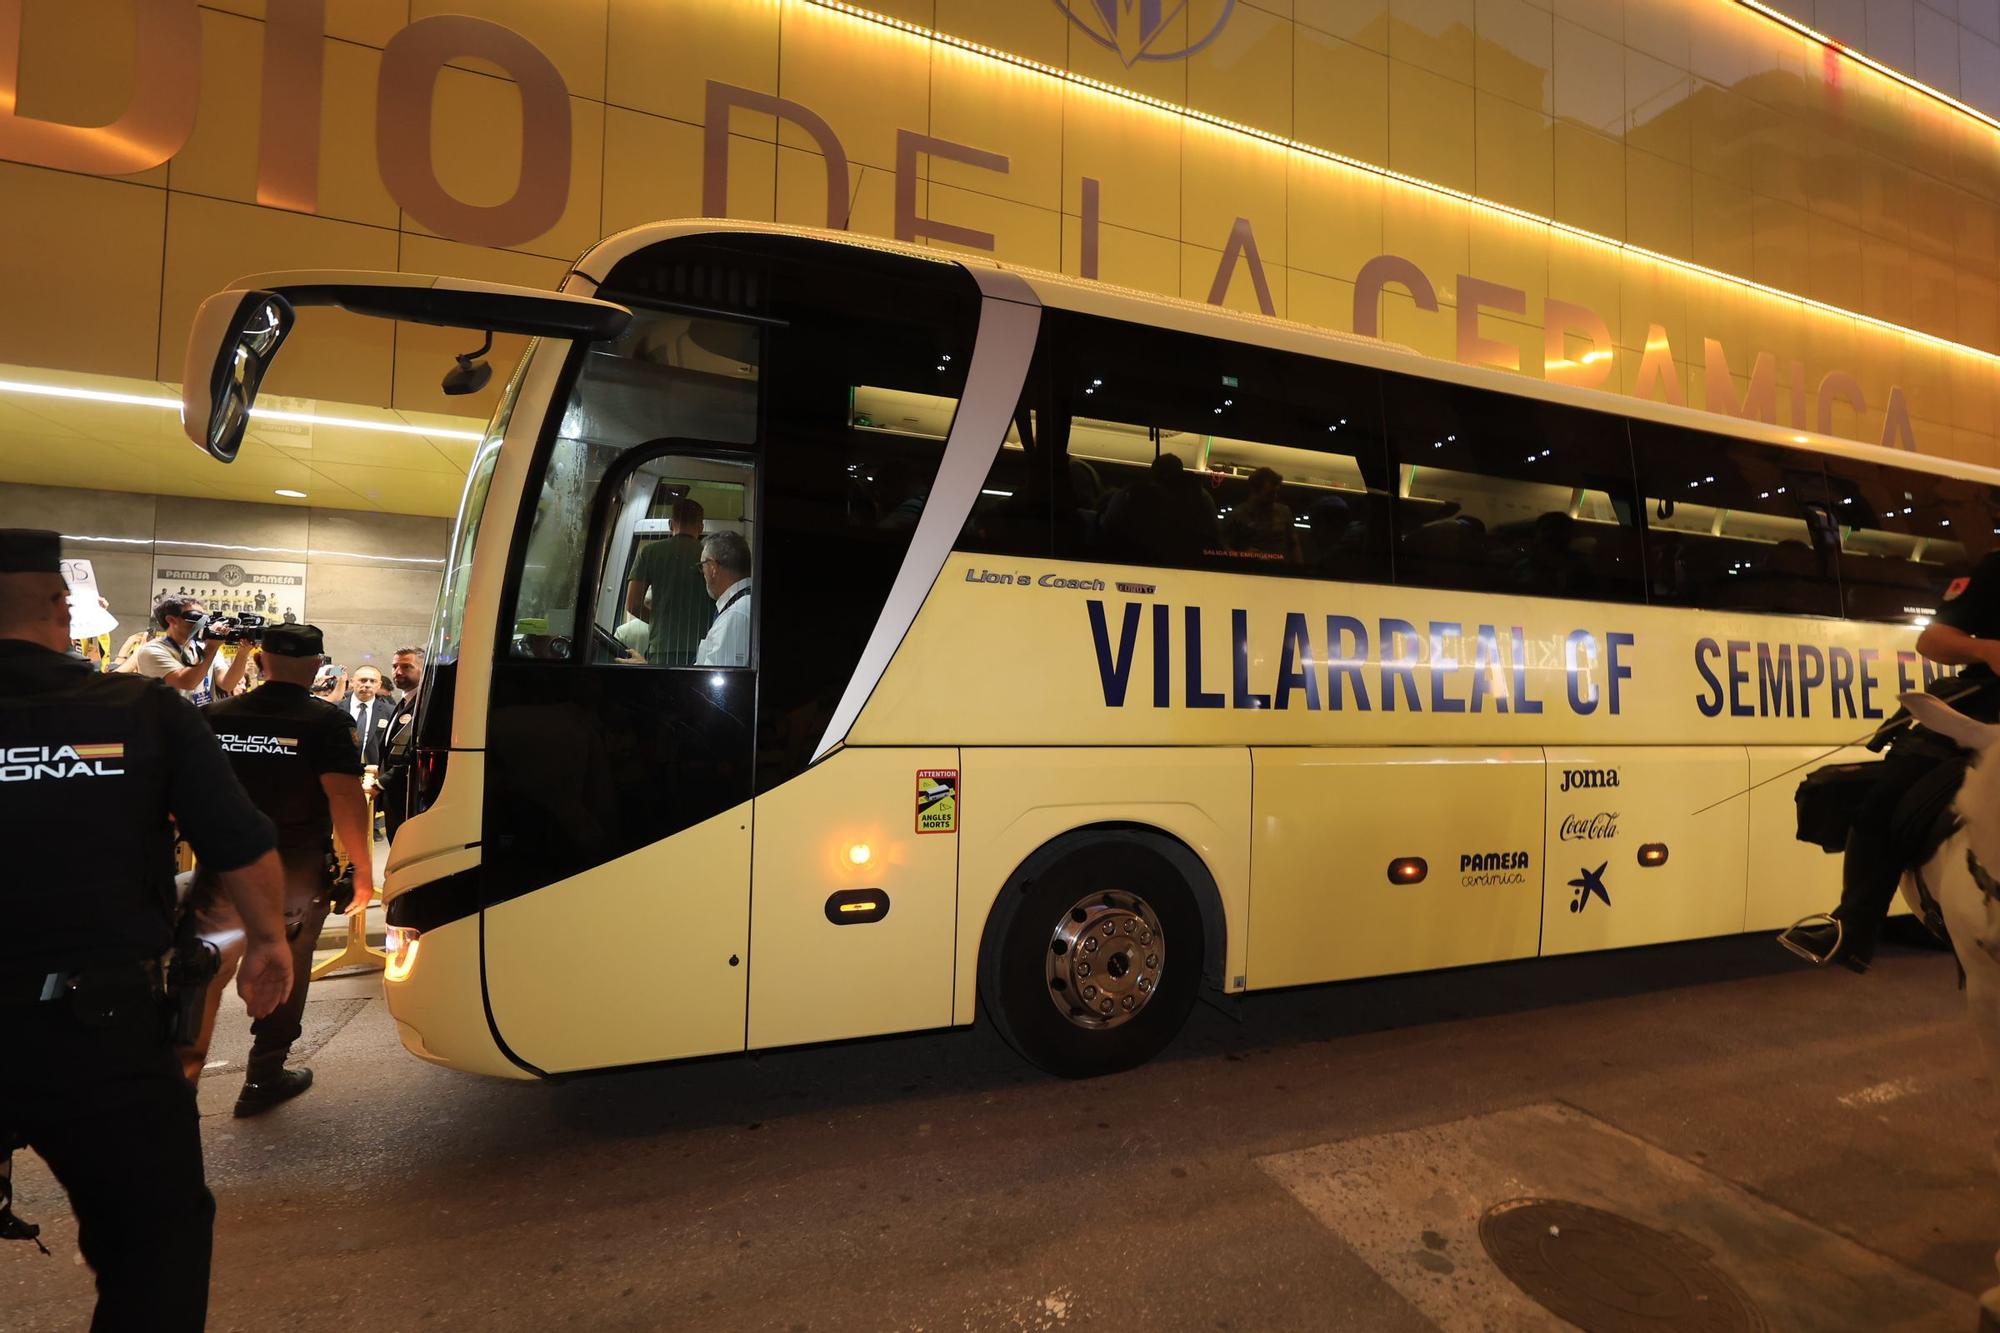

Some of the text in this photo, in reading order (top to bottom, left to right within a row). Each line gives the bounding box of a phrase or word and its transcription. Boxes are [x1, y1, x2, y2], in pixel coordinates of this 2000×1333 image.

[165, 570, 295, 585] PAMESA PAMESA
[965, 568, 1106, 591] Lion's Coach
[1086, 599, 1634, 716] VILLARREAL CF
[1695, 637, 1884, 719] SEMPRE
[1560, 812, 1620, 842] Coca-Cola
[1460, 851, 1529, 872] PAMESA
